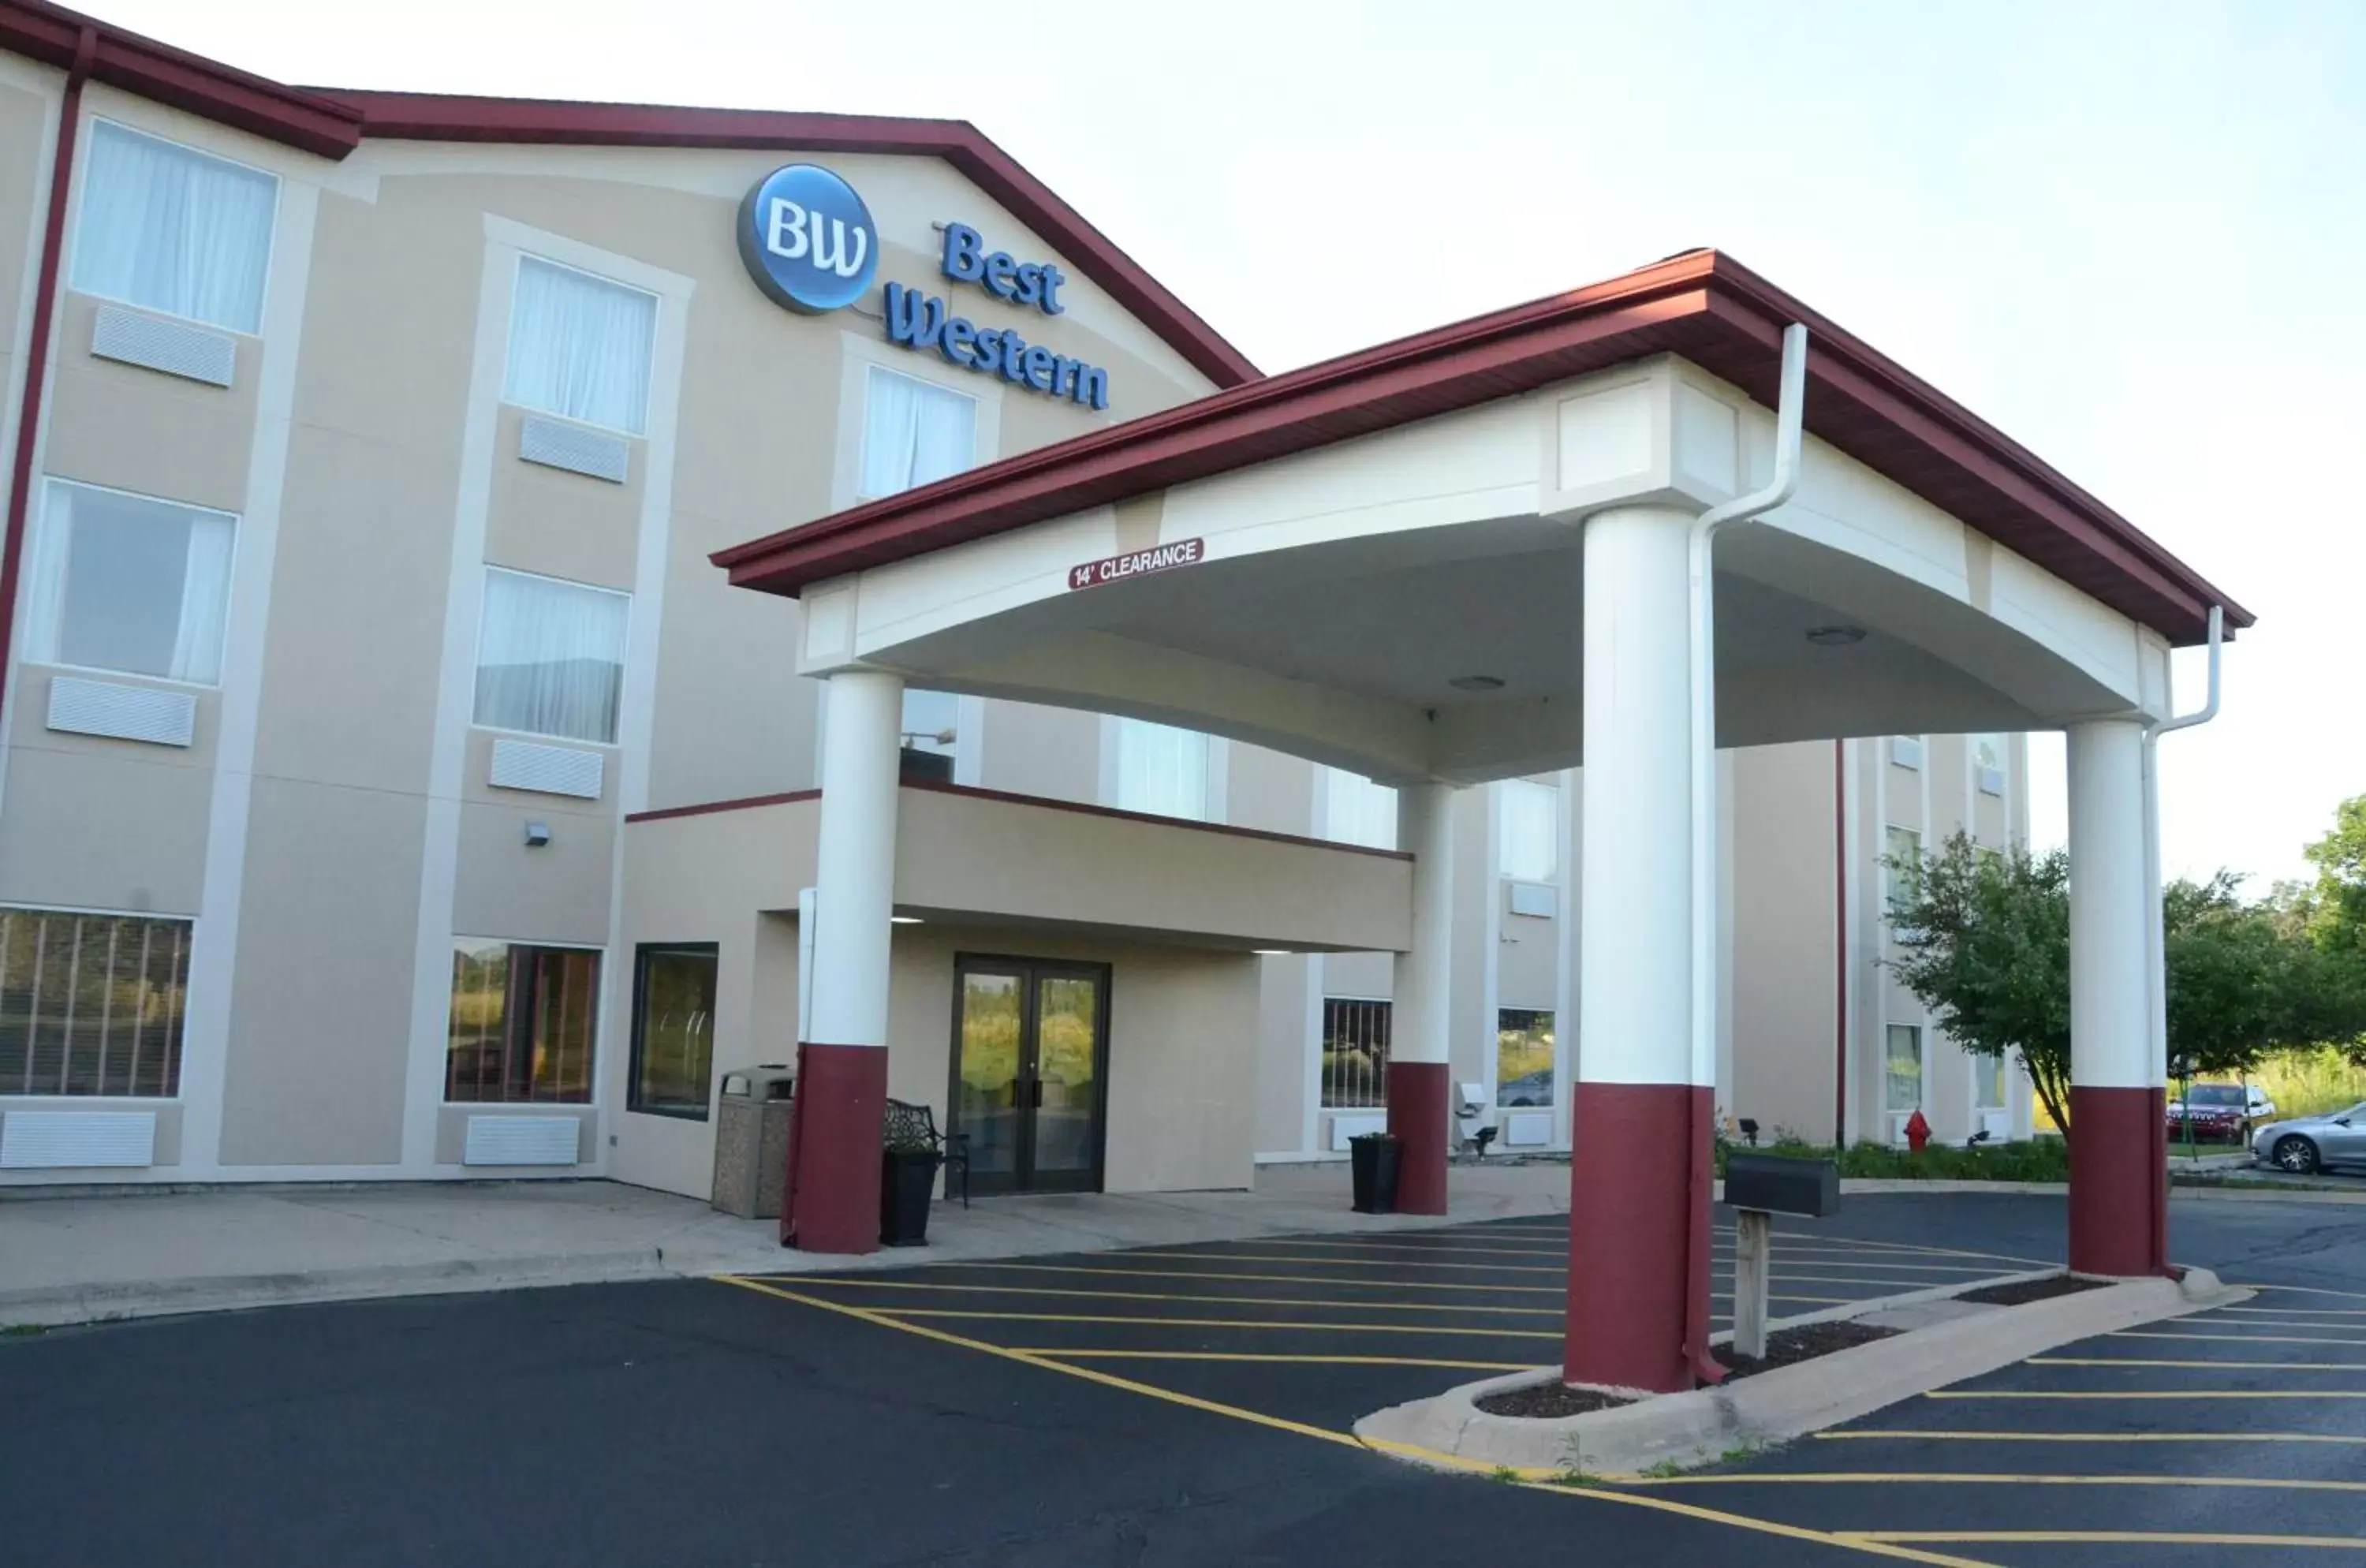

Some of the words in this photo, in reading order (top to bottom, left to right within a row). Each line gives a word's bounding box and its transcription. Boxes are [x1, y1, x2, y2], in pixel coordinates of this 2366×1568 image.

[767, 196, 867, 278] BW
[942, 222, 1065, 315] Best
[884, 281, 1109, 410] Western
[1074, 565, 1095, 586] 14'
[1100, 542, 1197, 580] CLEARANCE
